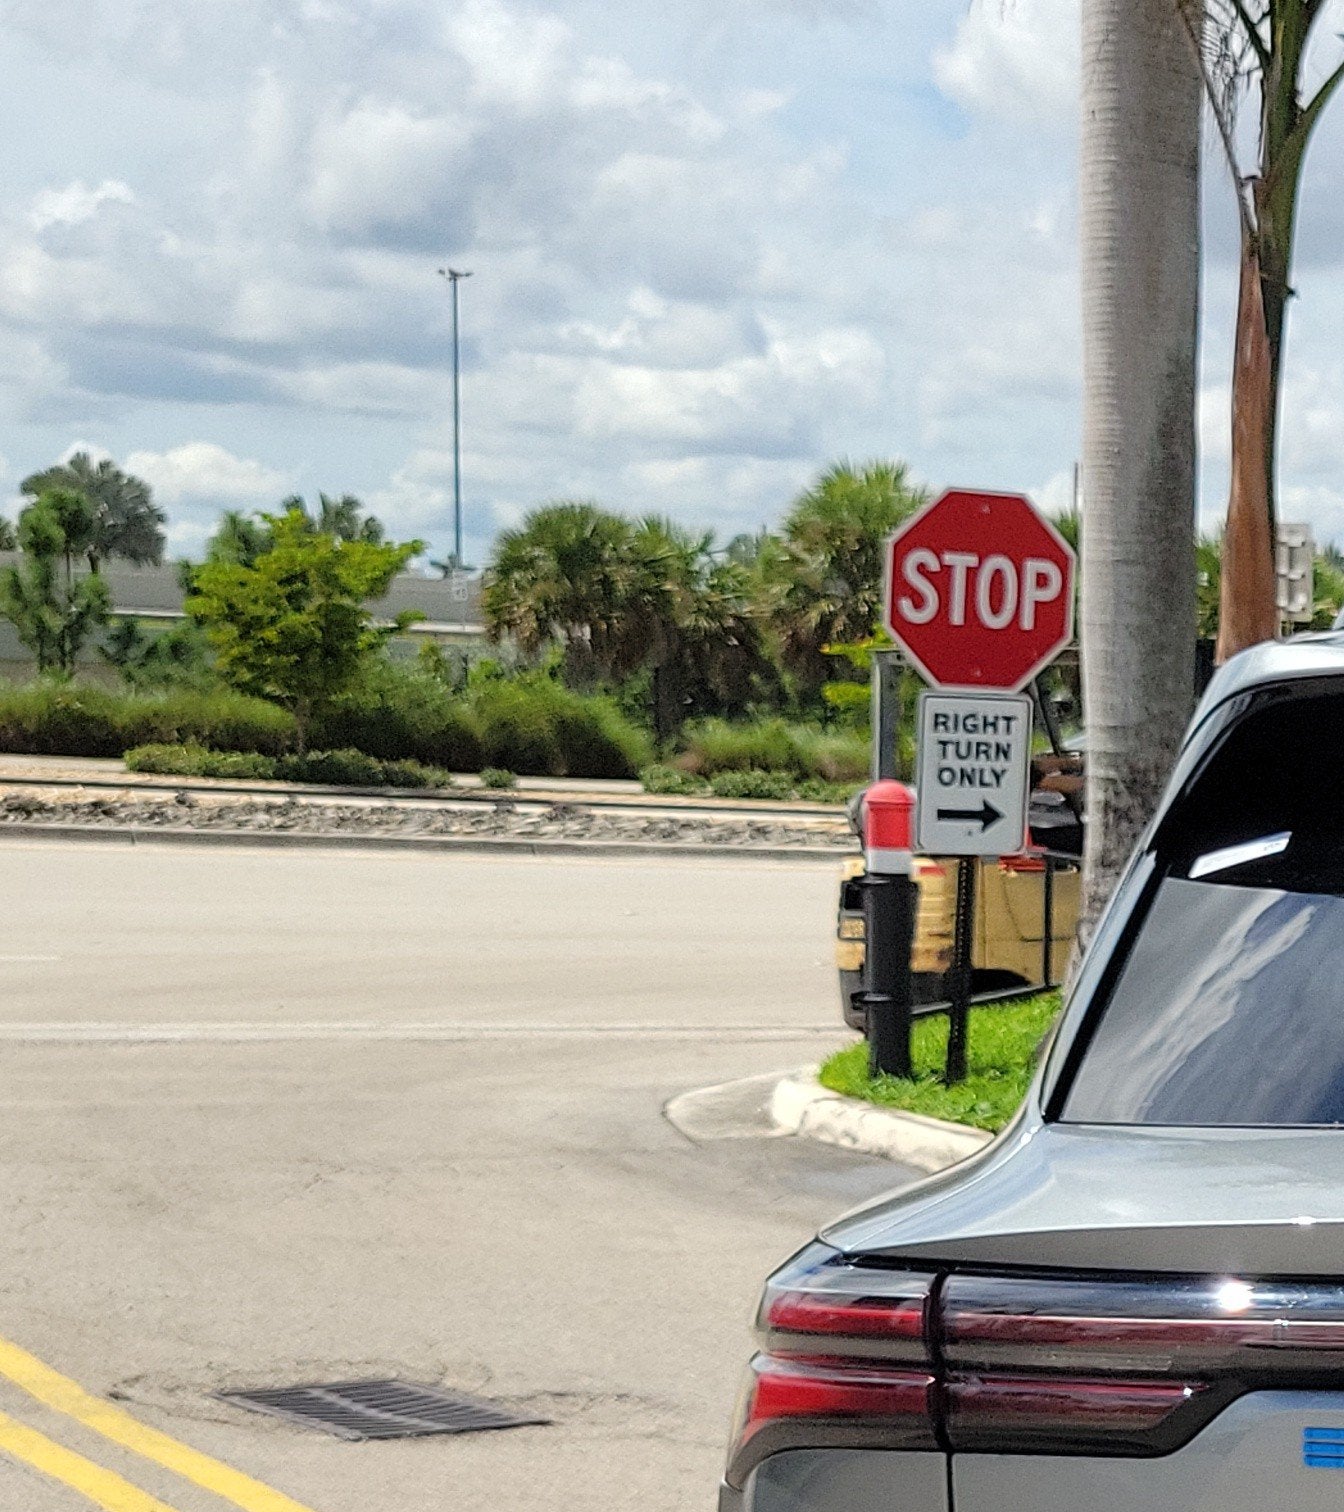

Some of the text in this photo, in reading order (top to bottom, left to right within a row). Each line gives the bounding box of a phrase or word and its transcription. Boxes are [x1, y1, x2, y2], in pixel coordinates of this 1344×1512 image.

[899, 548, 1062, 631] STOP
[933, 713, 1018, 735] RIGHT
[938, 740, 1012, 761] TURN
[938, 767, 1007, 788] ONLY
